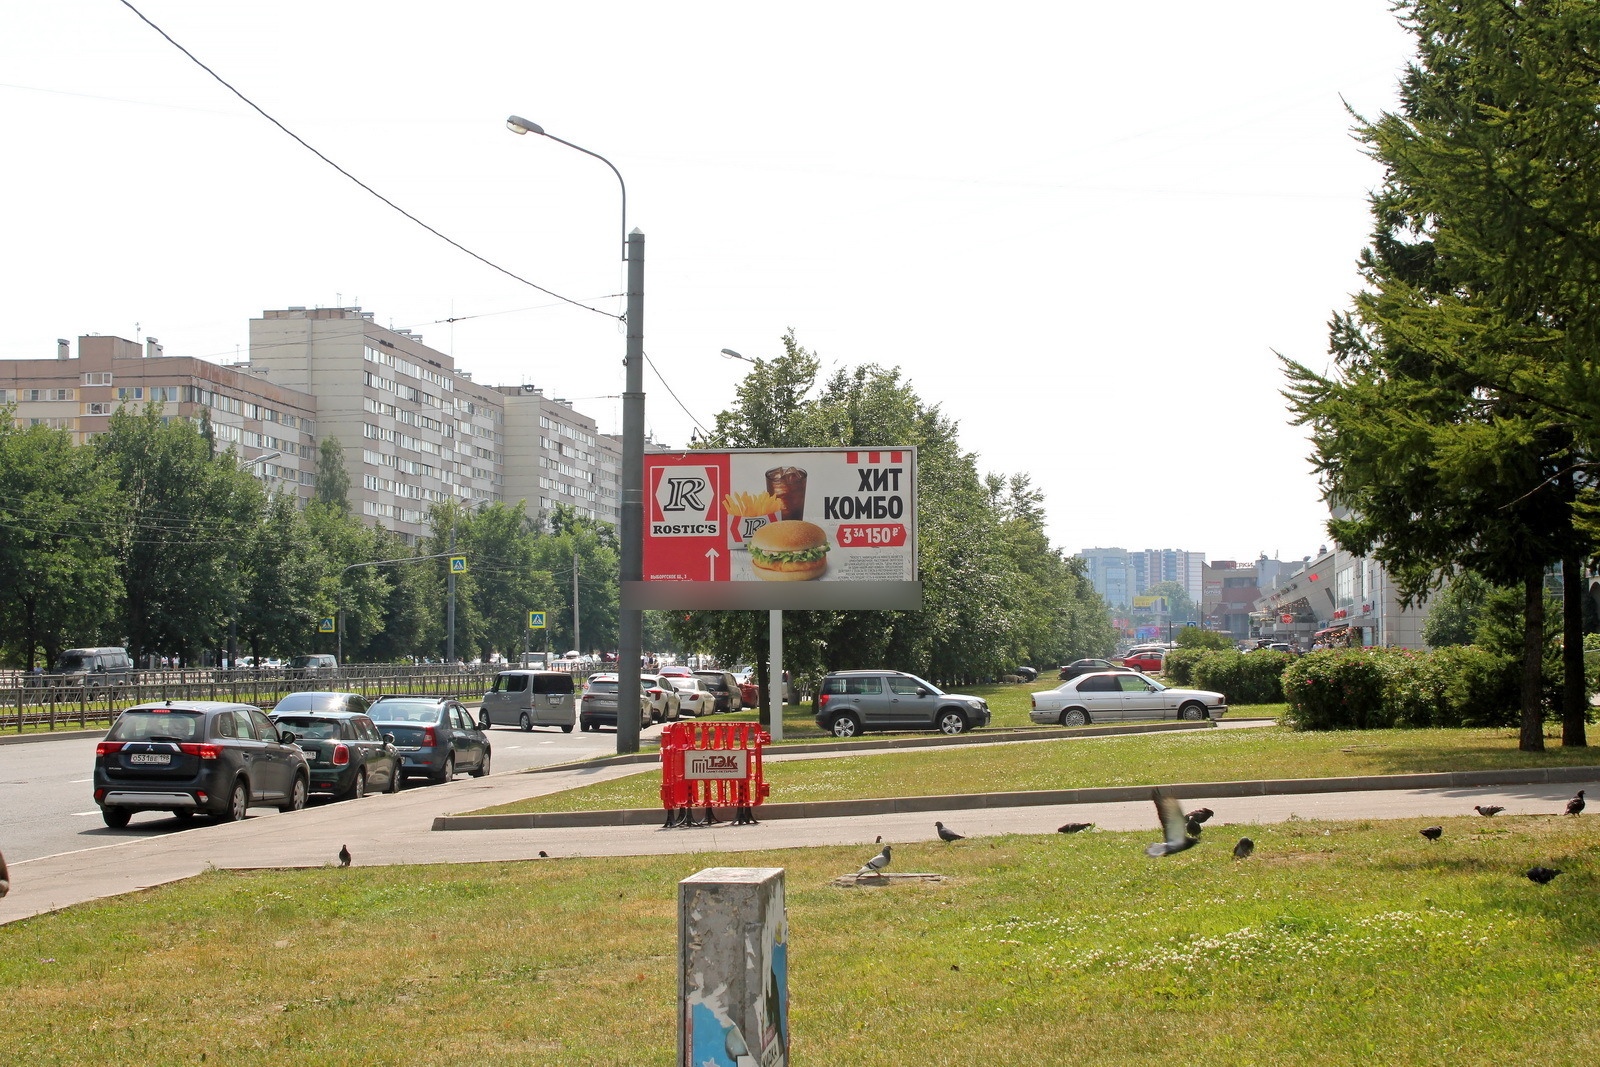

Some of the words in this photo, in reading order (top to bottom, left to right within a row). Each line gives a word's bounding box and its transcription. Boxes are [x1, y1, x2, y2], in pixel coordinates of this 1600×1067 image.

[858, 468, 902, 491] ХИТ
[663, 477, 705, 511] R
[824, 495, 903, 519] КОМБО
[653, 524, 717, 534] ROSTIC'S
[843, 528, 852, 543] 3
[853, 528, 865, 537] ЗА
[865, 527, 891, 543] 150
[709, 756, 738, 768] ТЭК
